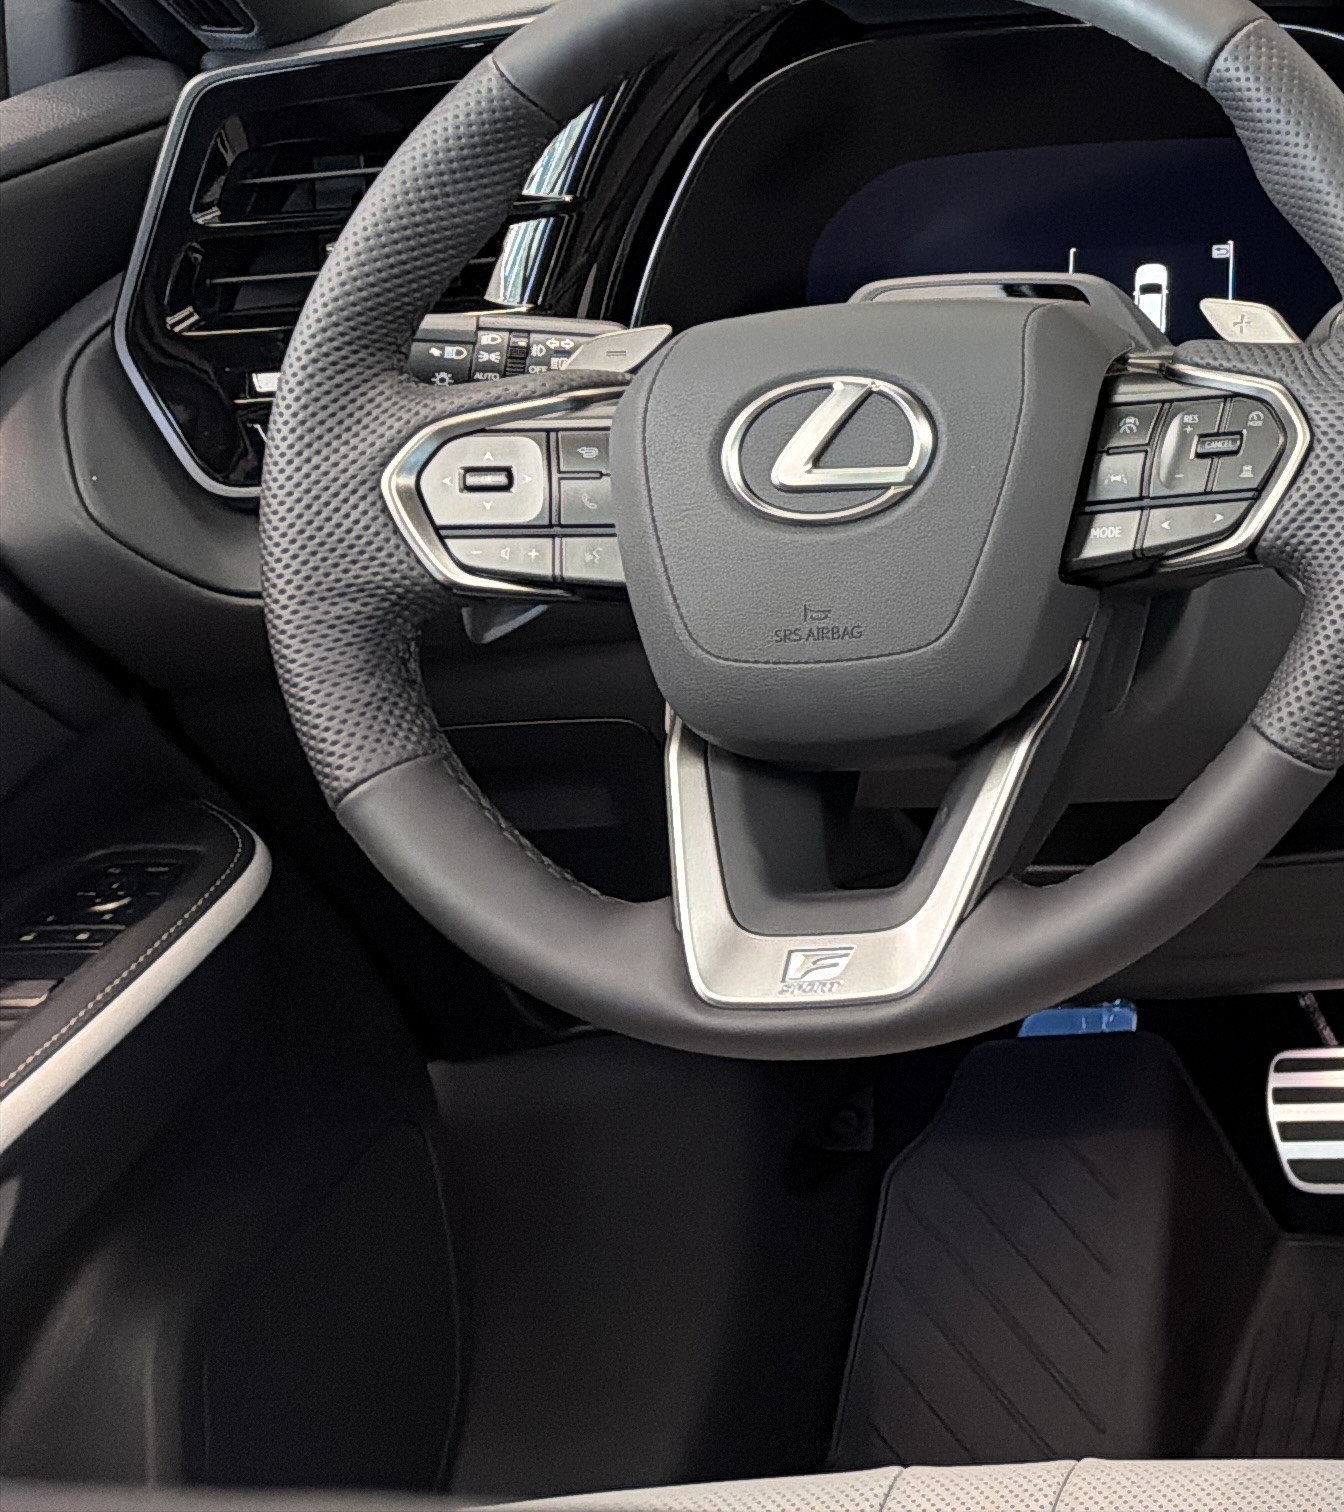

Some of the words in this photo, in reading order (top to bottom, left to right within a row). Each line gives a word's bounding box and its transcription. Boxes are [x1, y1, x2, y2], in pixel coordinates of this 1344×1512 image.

[528, 365, 548, 374] OFF
[474, 371, 500, 382] AUTO
[1183, 414, 1199, 424] RES
[1204, 439, 1233, 450] CANCEL
[1090, 525, 1122, 539] MODE
[774, 628, 802, 643] SRS
[805, 624, 863, 642] AIRBAG
